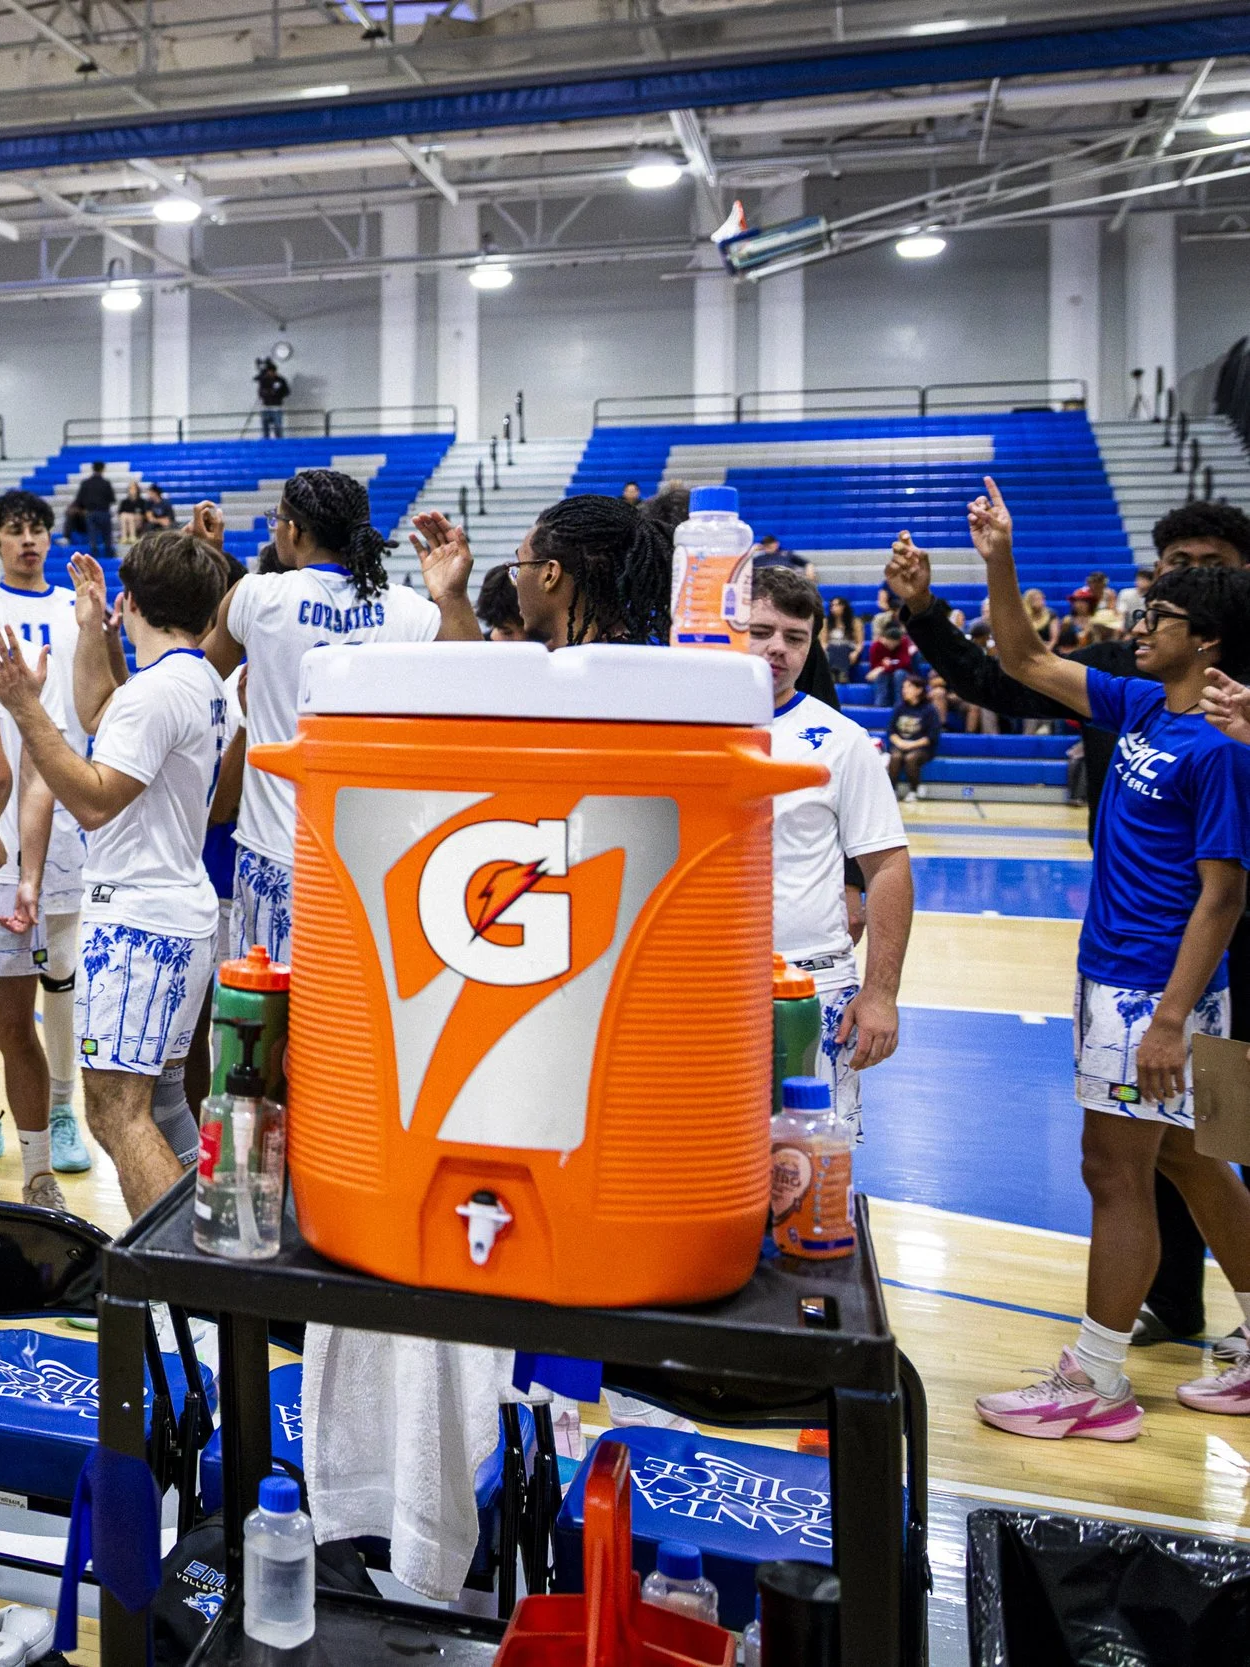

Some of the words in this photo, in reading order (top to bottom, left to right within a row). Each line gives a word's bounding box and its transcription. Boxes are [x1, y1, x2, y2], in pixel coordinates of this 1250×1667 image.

[298, 600, 385, 634] CORSAIRS
[418, 818, 572, 987] G
[636, 1488, 833, 1548] SANTA
